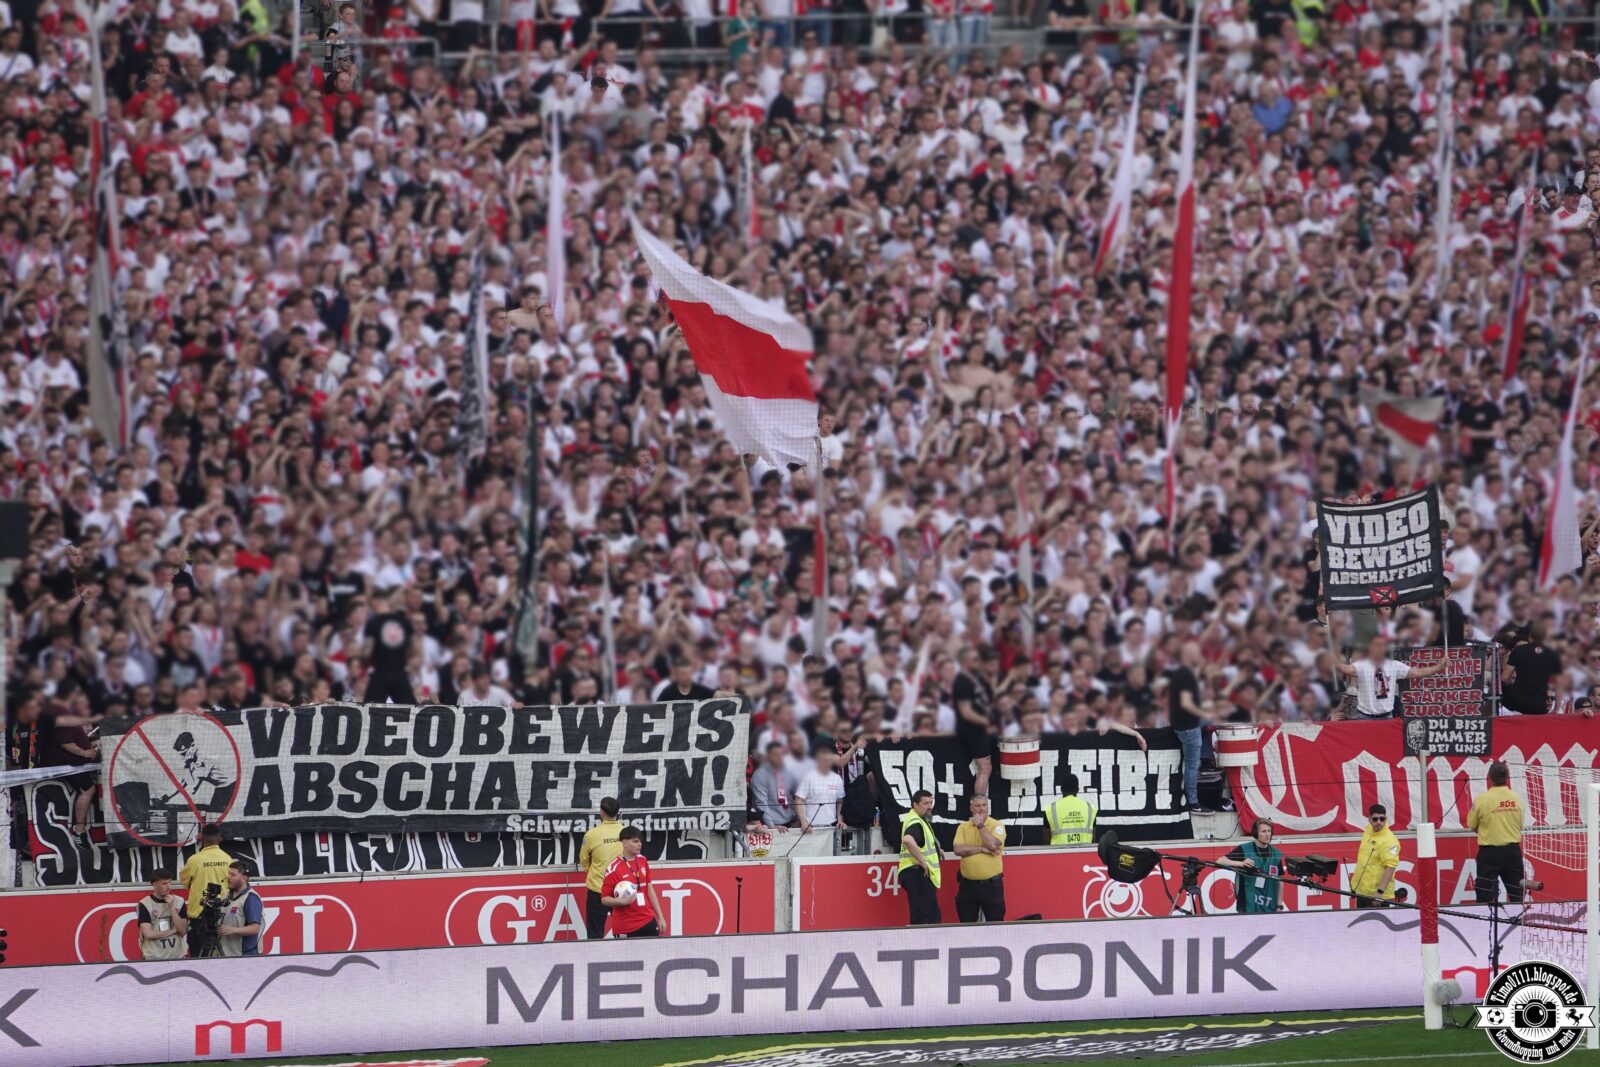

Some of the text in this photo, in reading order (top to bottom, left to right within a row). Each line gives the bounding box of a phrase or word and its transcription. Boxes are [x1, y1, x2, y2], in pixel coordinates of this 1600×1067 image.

[1324, 501, 1430, 545] VIDEO
[1327, 533, 1431, 569] BEWEIS
[1330, 559, 1432, 584] ABSCHAFFEN!
[1410, 648, 1472, 660] JEDER
[1410, 676, 1475, 689] KEHRT
[1403, 702, 1482, 717] ZURÜCK
[246, 699, 736, 758] VIDEOBEWEIS
[1429, 719, 1487, 730] DU BIST
[1429, 731, 1487, 743] IMMER
[1429, 744, 1488, 754] BEI UNS!
[243, 755, 730, 816] ABSCHAFFEN!
[867, 865, 902, 897] 34
[160, 937, 176, 949] TV
[486, 934, 1278, 1025] MECHATRONIK
